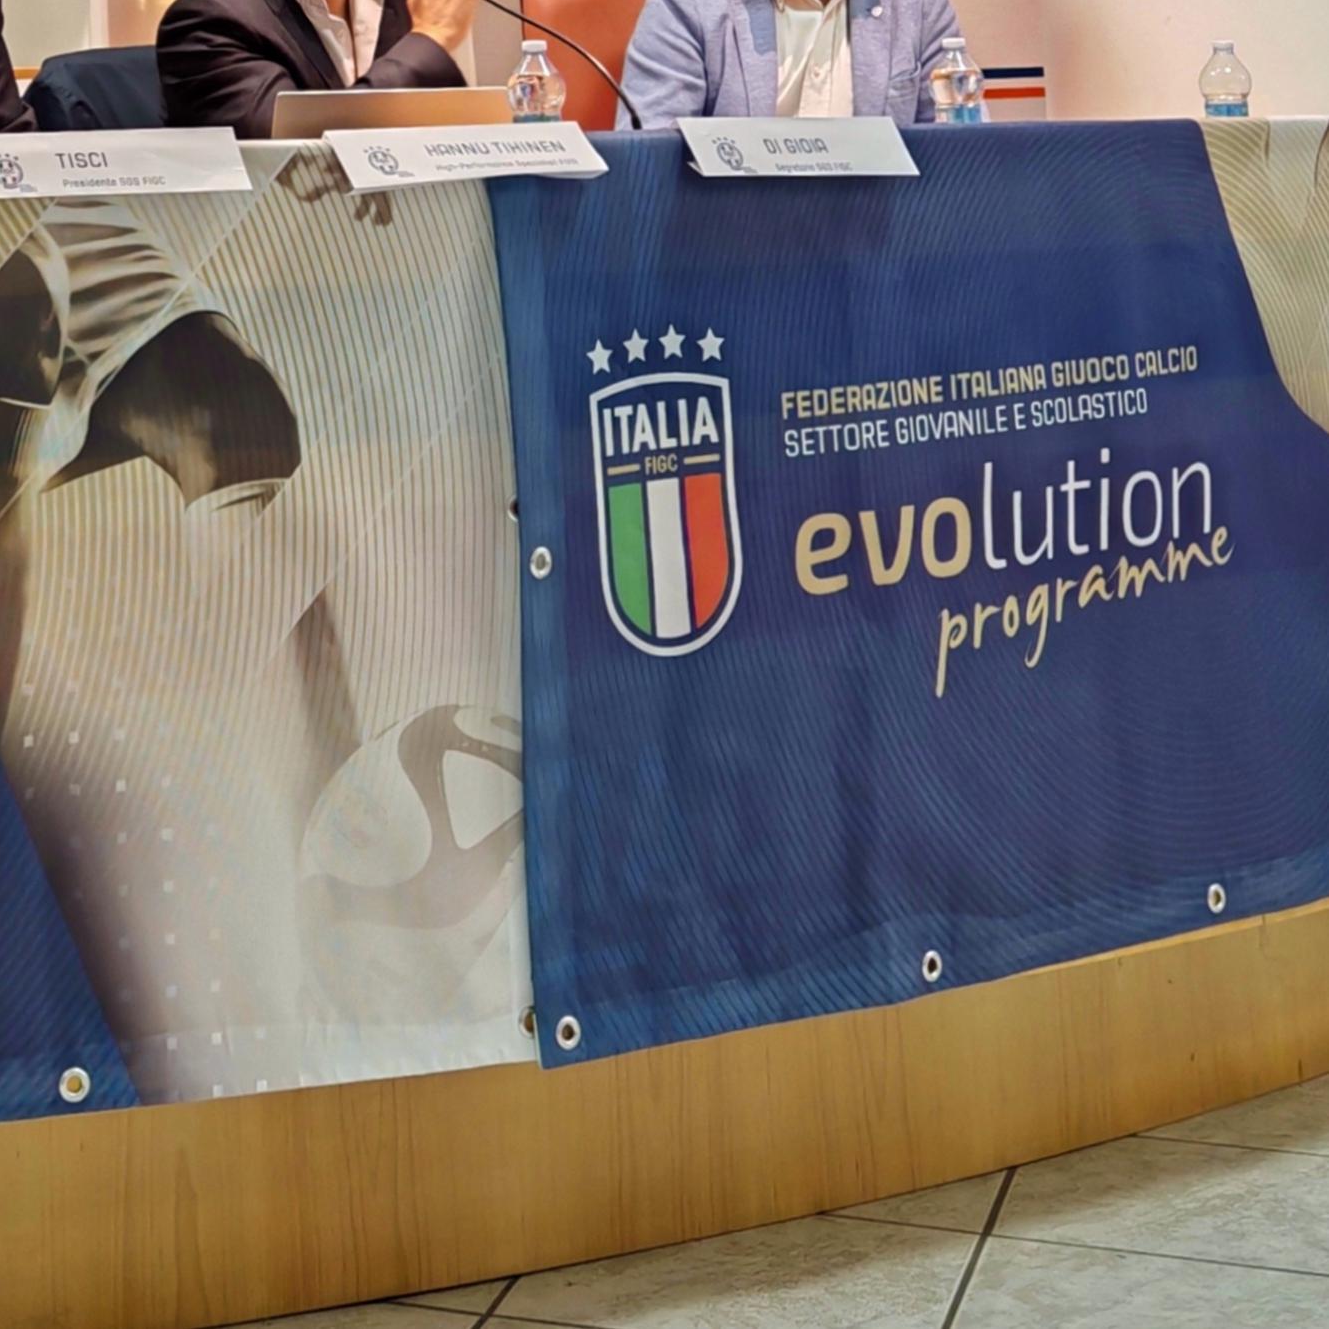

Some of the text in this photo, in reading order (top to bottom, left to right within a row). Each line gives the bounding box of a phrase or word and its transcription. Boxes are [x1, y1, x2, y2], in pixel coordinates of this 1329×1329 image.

[55, 152, 108, 170] TISCI
[424, 139, 567, 158] HANNU TIHINEN
[762, 137, 830, 155] DI GIOIA
[62, 177, 117, 188] Presidente
[780, 344, 1199, 421] FEDERAZIONE ITALIANA GIUOCO CALCIO
[602, 395, 720, 458] ITALIA
[783, 387, 1149, 458] SETTORE GIOVANILE E SCOLASTICO
[643, 452, 679, 475] FIGC
[793, 446, 1213, 596] evolution
[934, 525, 1236, 699] programme
